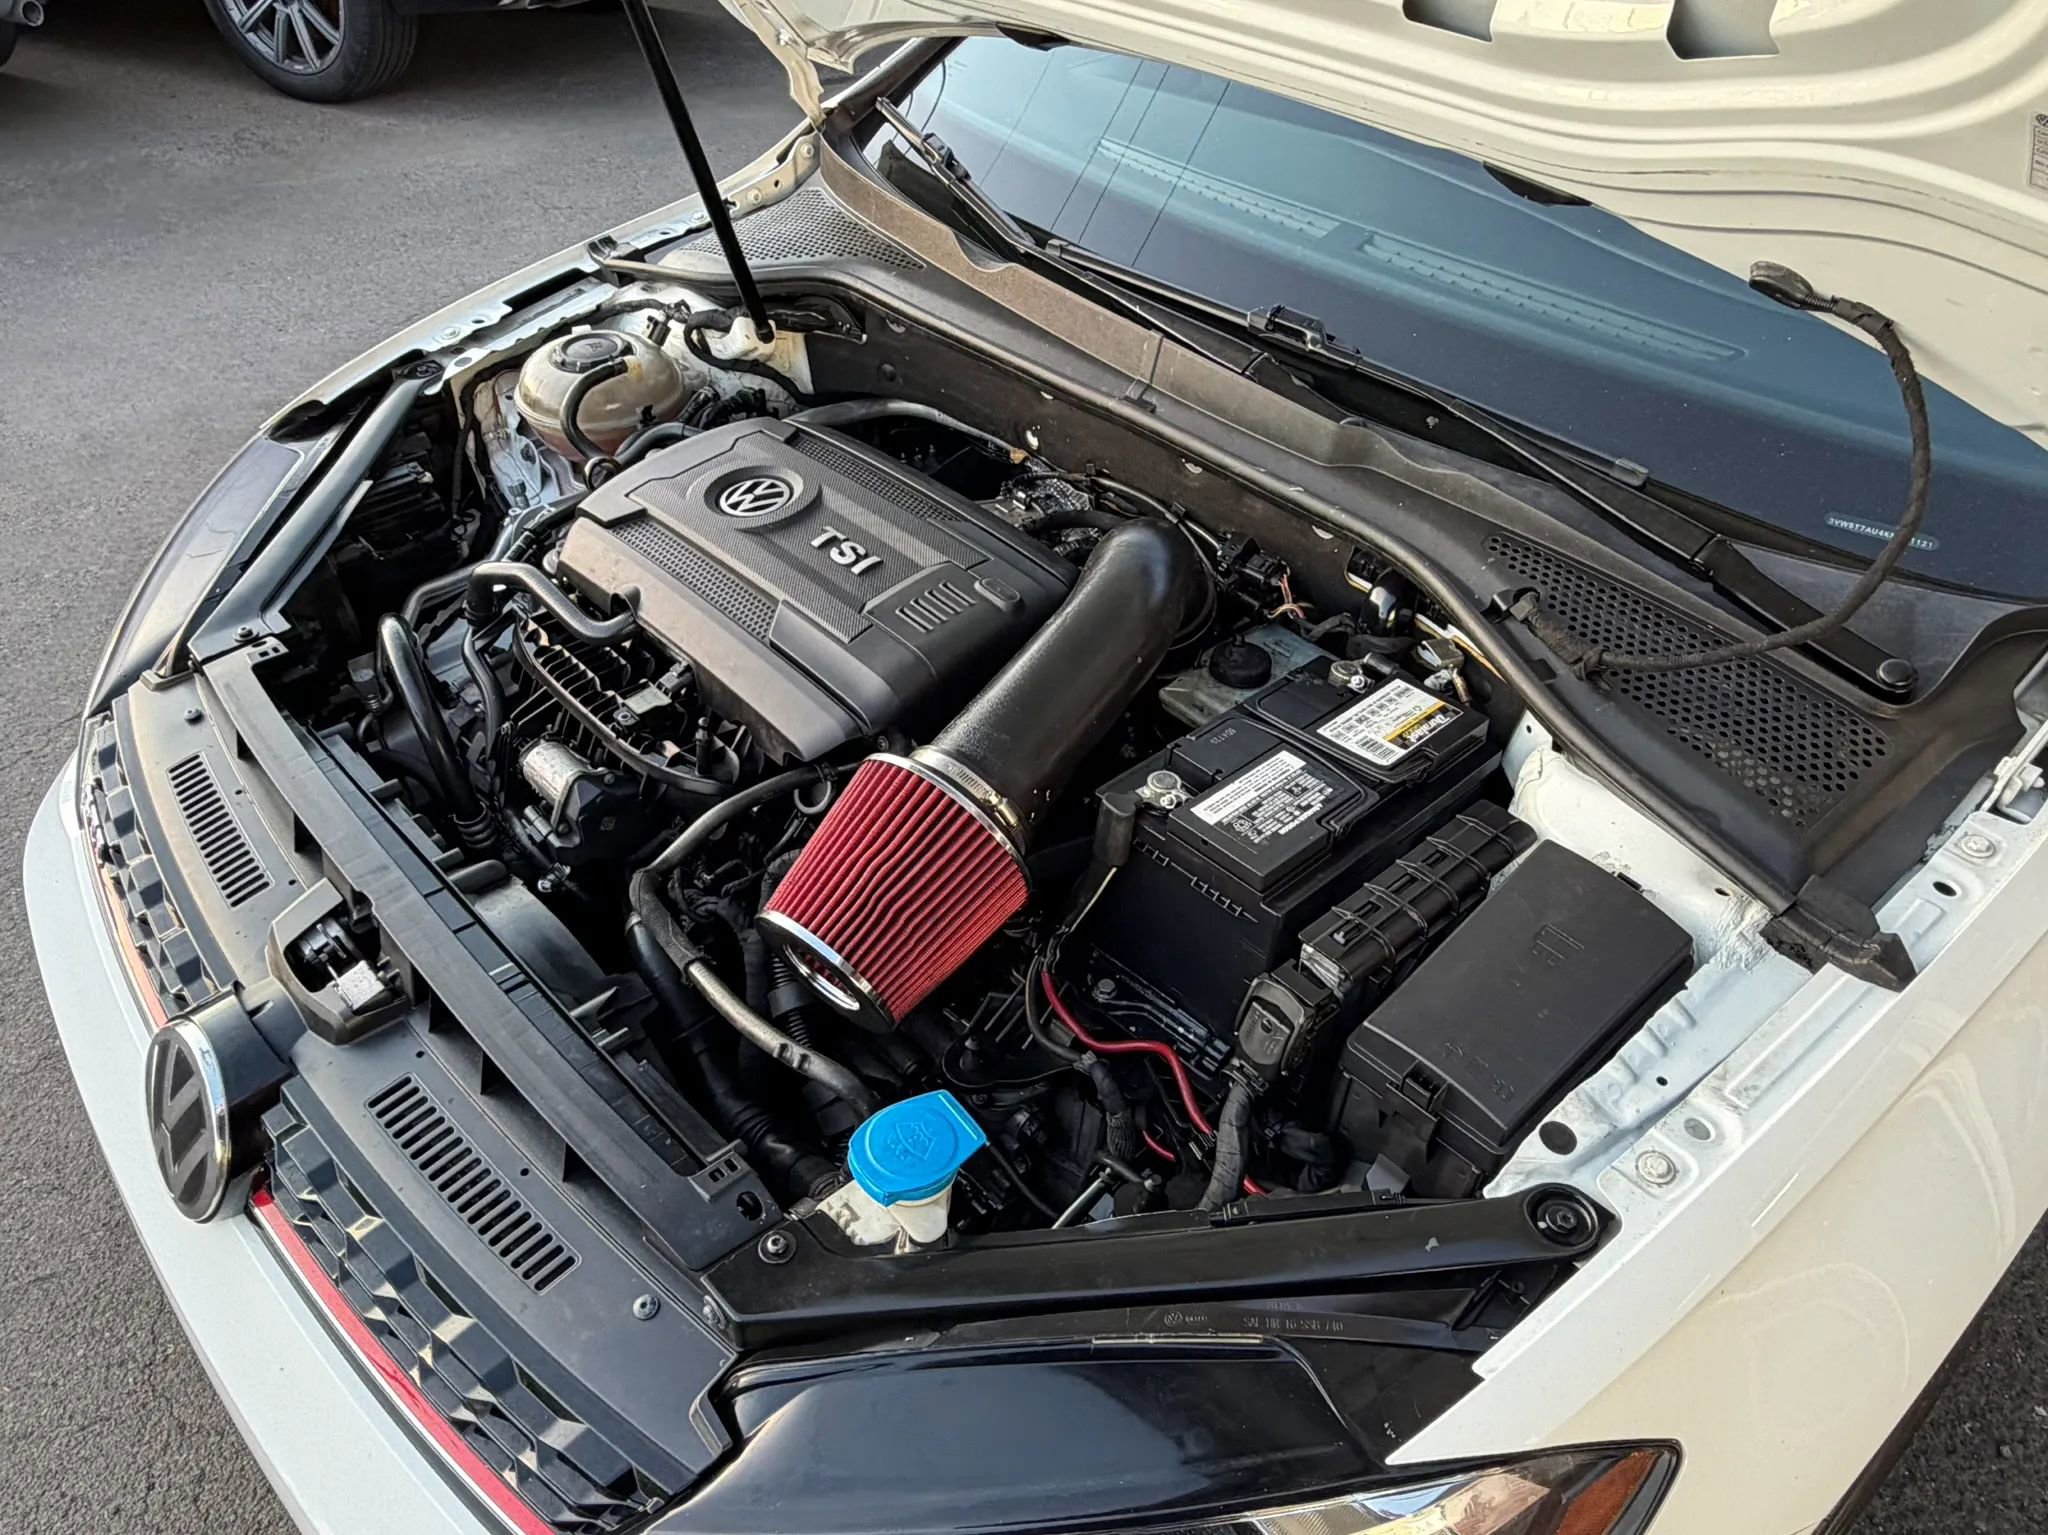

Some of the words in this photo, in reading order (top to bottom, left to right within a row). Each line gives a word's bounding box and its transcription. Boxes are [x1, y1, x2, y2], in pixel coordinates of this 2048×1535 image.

[719, 477, 791, 517] VW
[810, 525, 884, 576] TSI
[1407, 714, 1450, 743] Duralast
